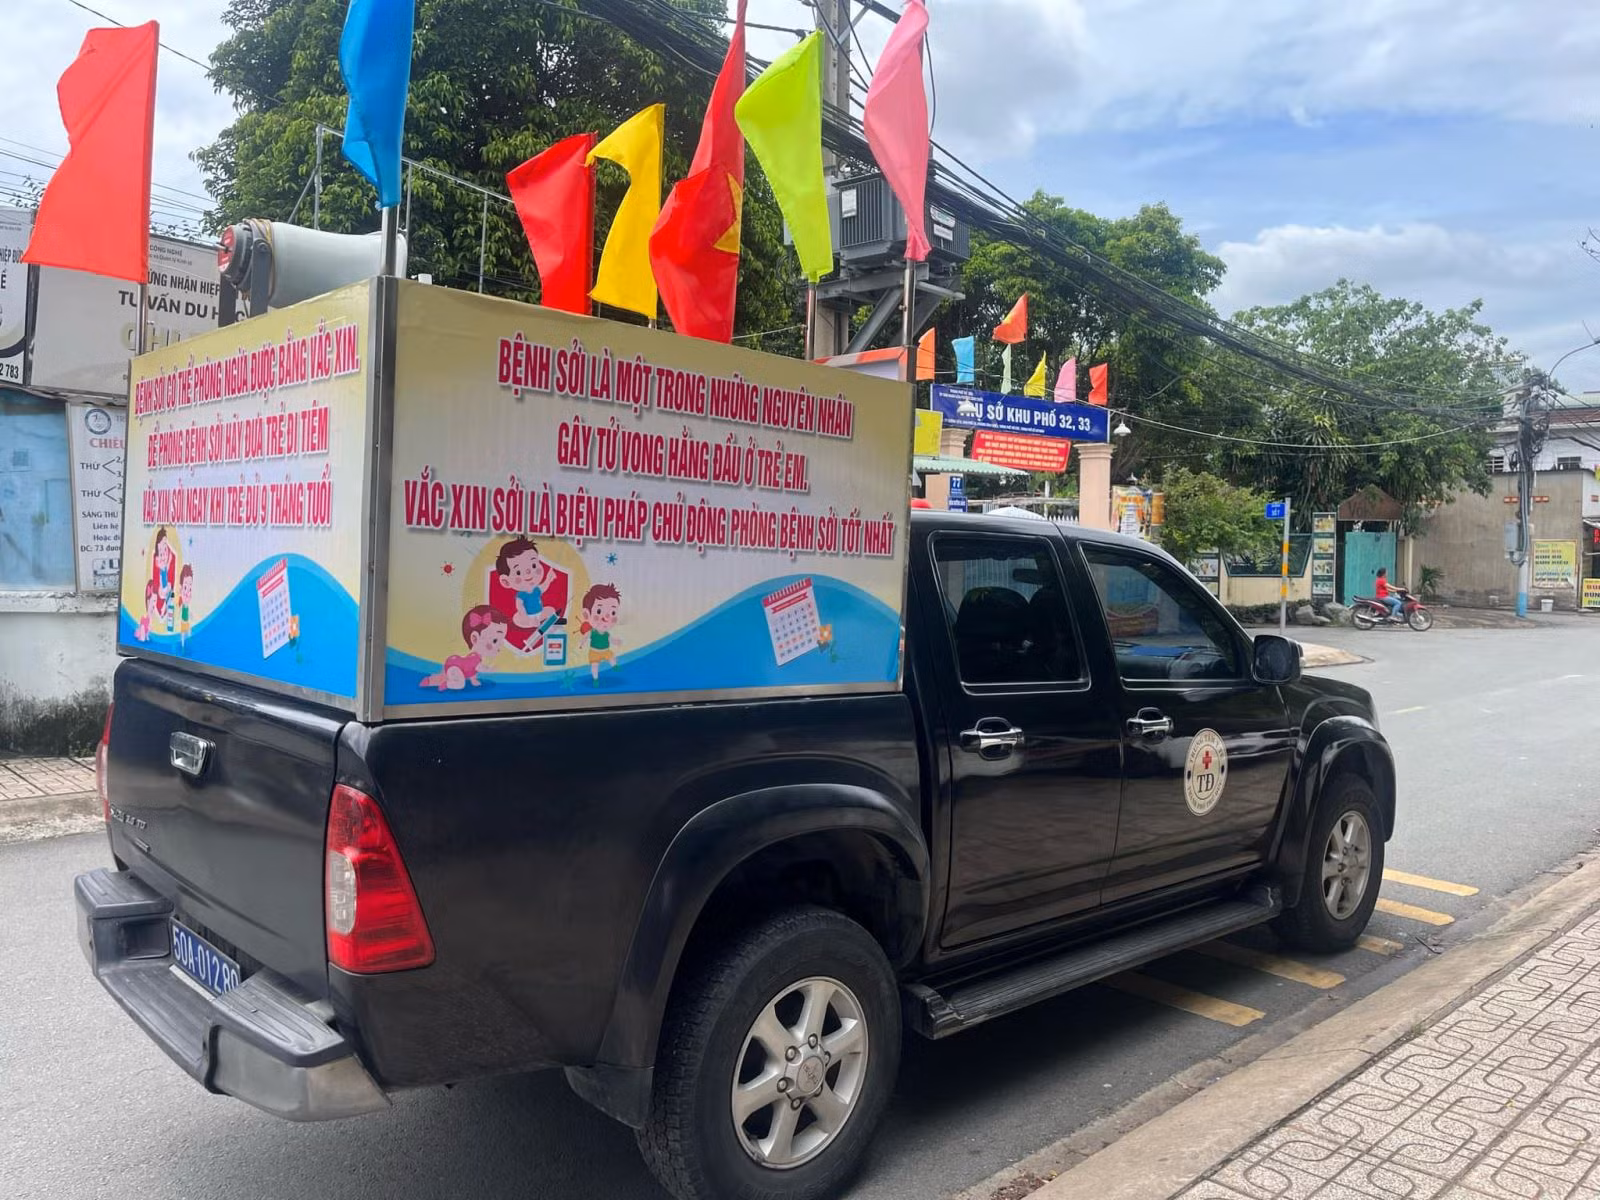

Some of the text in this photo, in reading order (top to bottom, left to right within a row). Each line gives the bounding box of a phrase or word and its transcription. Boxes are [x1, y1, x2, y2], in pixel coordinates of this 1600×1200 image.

[148, 292, 180, 314] VẤN
[184, 302, 208, 318] DU
[170, 275, 197, 294] NHẬN
[6, 364, 19, 380] 783
[178, 354, 192, 406] THỂ
[194, 356, 222, 403] PHÒNG
[224, 348, 248, 397] NGỪA
[251, 342, 276, 399] ĐƯỢC
[278, 328, 307, 386] BẰNG
[310, 318, 331, 379] VẮC
[334, 324, 360, 374] XIN.
[498, 332, 852, 438] BỆNH SỞI LÀ MỘT TRONG NHỮNG NGUYÊN NHÂN
[160, 424, 182, 465] PHÒNG
[184, 421, 207, 476] BỆNH
[208, 413, 224, 462] SỞI
[225, 414, 243, 460] HÃY
[266, 402, 286, 456] TRẺ
[287, 412, 298, 453] ĐI
[302, 400, 328, 452] TIÊM
[986, 401, 1004, 421] SỞ
[1006, 407, 1030, 424] KHU
[1034, 408, 1056, 427] PHỐ
[1059, 414, 1076, 431] 32,
[1078, 416, 1090, 432] 33
[557, 415, 592, 467] GÂY
[596, 416, 620, 470] TỬ
[622, 430, 664, 476] VONG
[744, 436, 756, 486] Ở
[758, 440, 782, 488] TRẺ
[784, 452, 808, 491] EM.
[157, 488, 170, 523] XIN
[172, 478, 185, 524] SỞI
[186, 486, 208, 523] NGAY
[210, 486, 225, 523] KHI
[228, 474, 245, 524] TRẺ
[246, 474, 260, 524] ĐỦ
[260, 485, 268, 525] 9
[270, 474, 304, 524] THÁNG
[307, 464, 331, 525] TUỔI
[404, 465, 894, 558] VẮC XIN SỞI LÀ BIỆN PHÁP CHỦ ĐỘNG PHÒNG BỆNH SỞI TỐT NHẤT
[1197, 773, 1214, 793] TĐ
